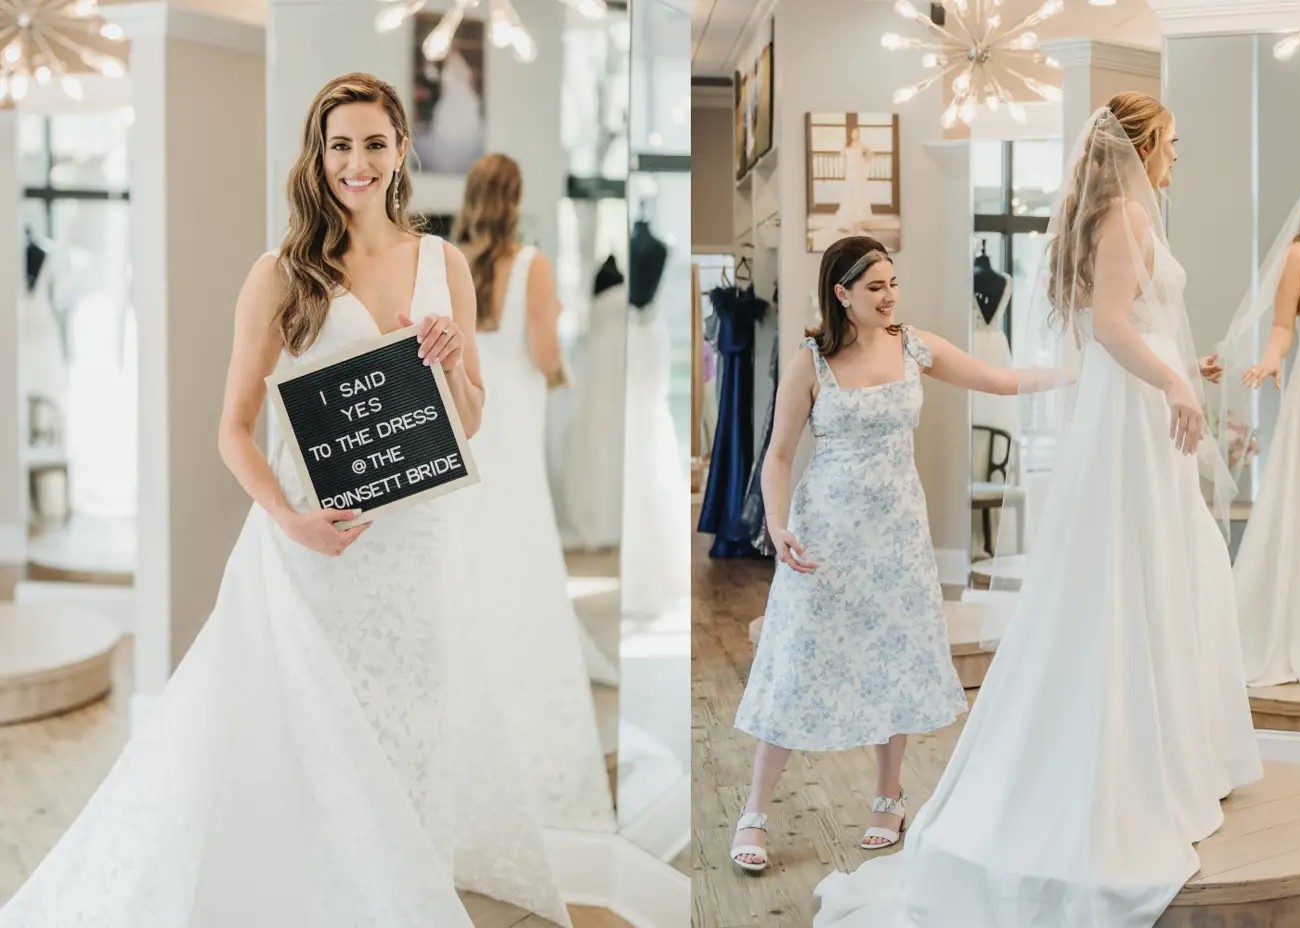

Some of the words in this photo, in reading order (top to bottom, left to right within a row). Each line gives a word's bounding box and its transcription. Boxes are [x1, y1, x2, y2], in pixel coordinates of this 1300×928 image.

[319, 390, 327, 405] I
[339, 370, 386, 398] SAID
[340, 397, 383, 422] YES
[308, 443, 332, 461] TO
[335, 428, 374, 453] THE
[376, 405, 438, 439] DRESS
[321, 472, 402, 511] POINSETT
[405, 452, 462, 486] BRIDE
